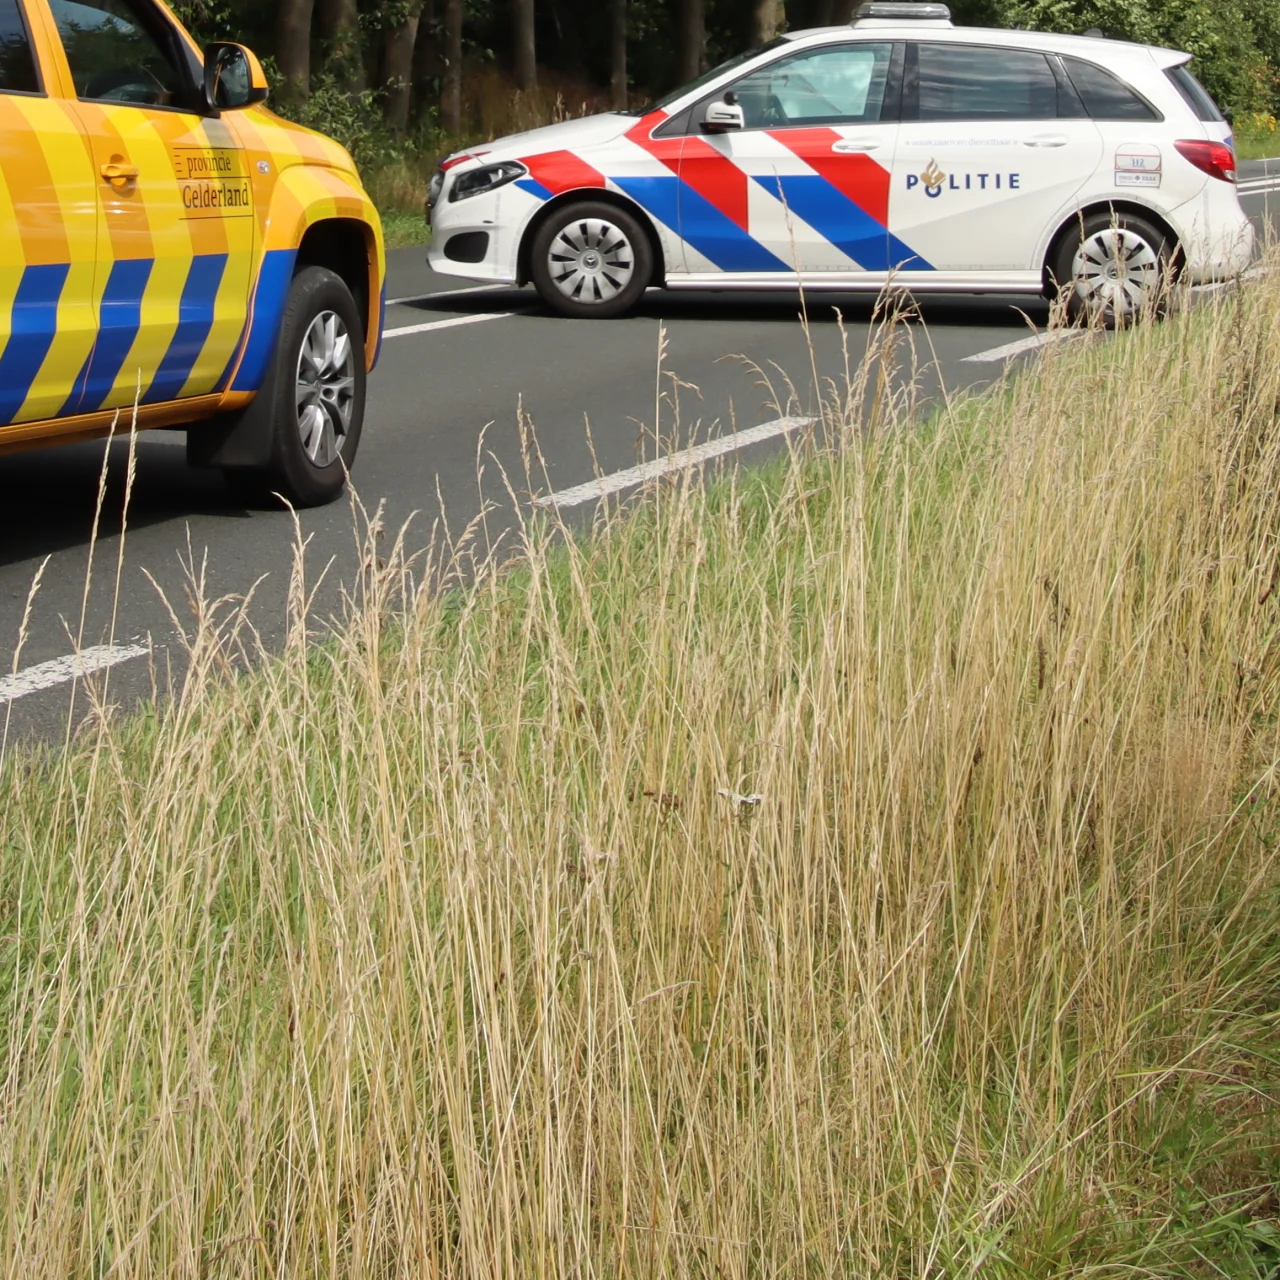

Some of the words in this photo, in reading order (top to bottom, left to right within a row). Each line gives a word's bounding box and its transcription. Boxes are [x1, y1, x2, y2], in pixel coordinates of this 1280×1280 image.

[186, 151, 232, 178] provincie
[182, 182, 249, 209] Gelderland
[906, 173, 1020, 198] POLITIE
